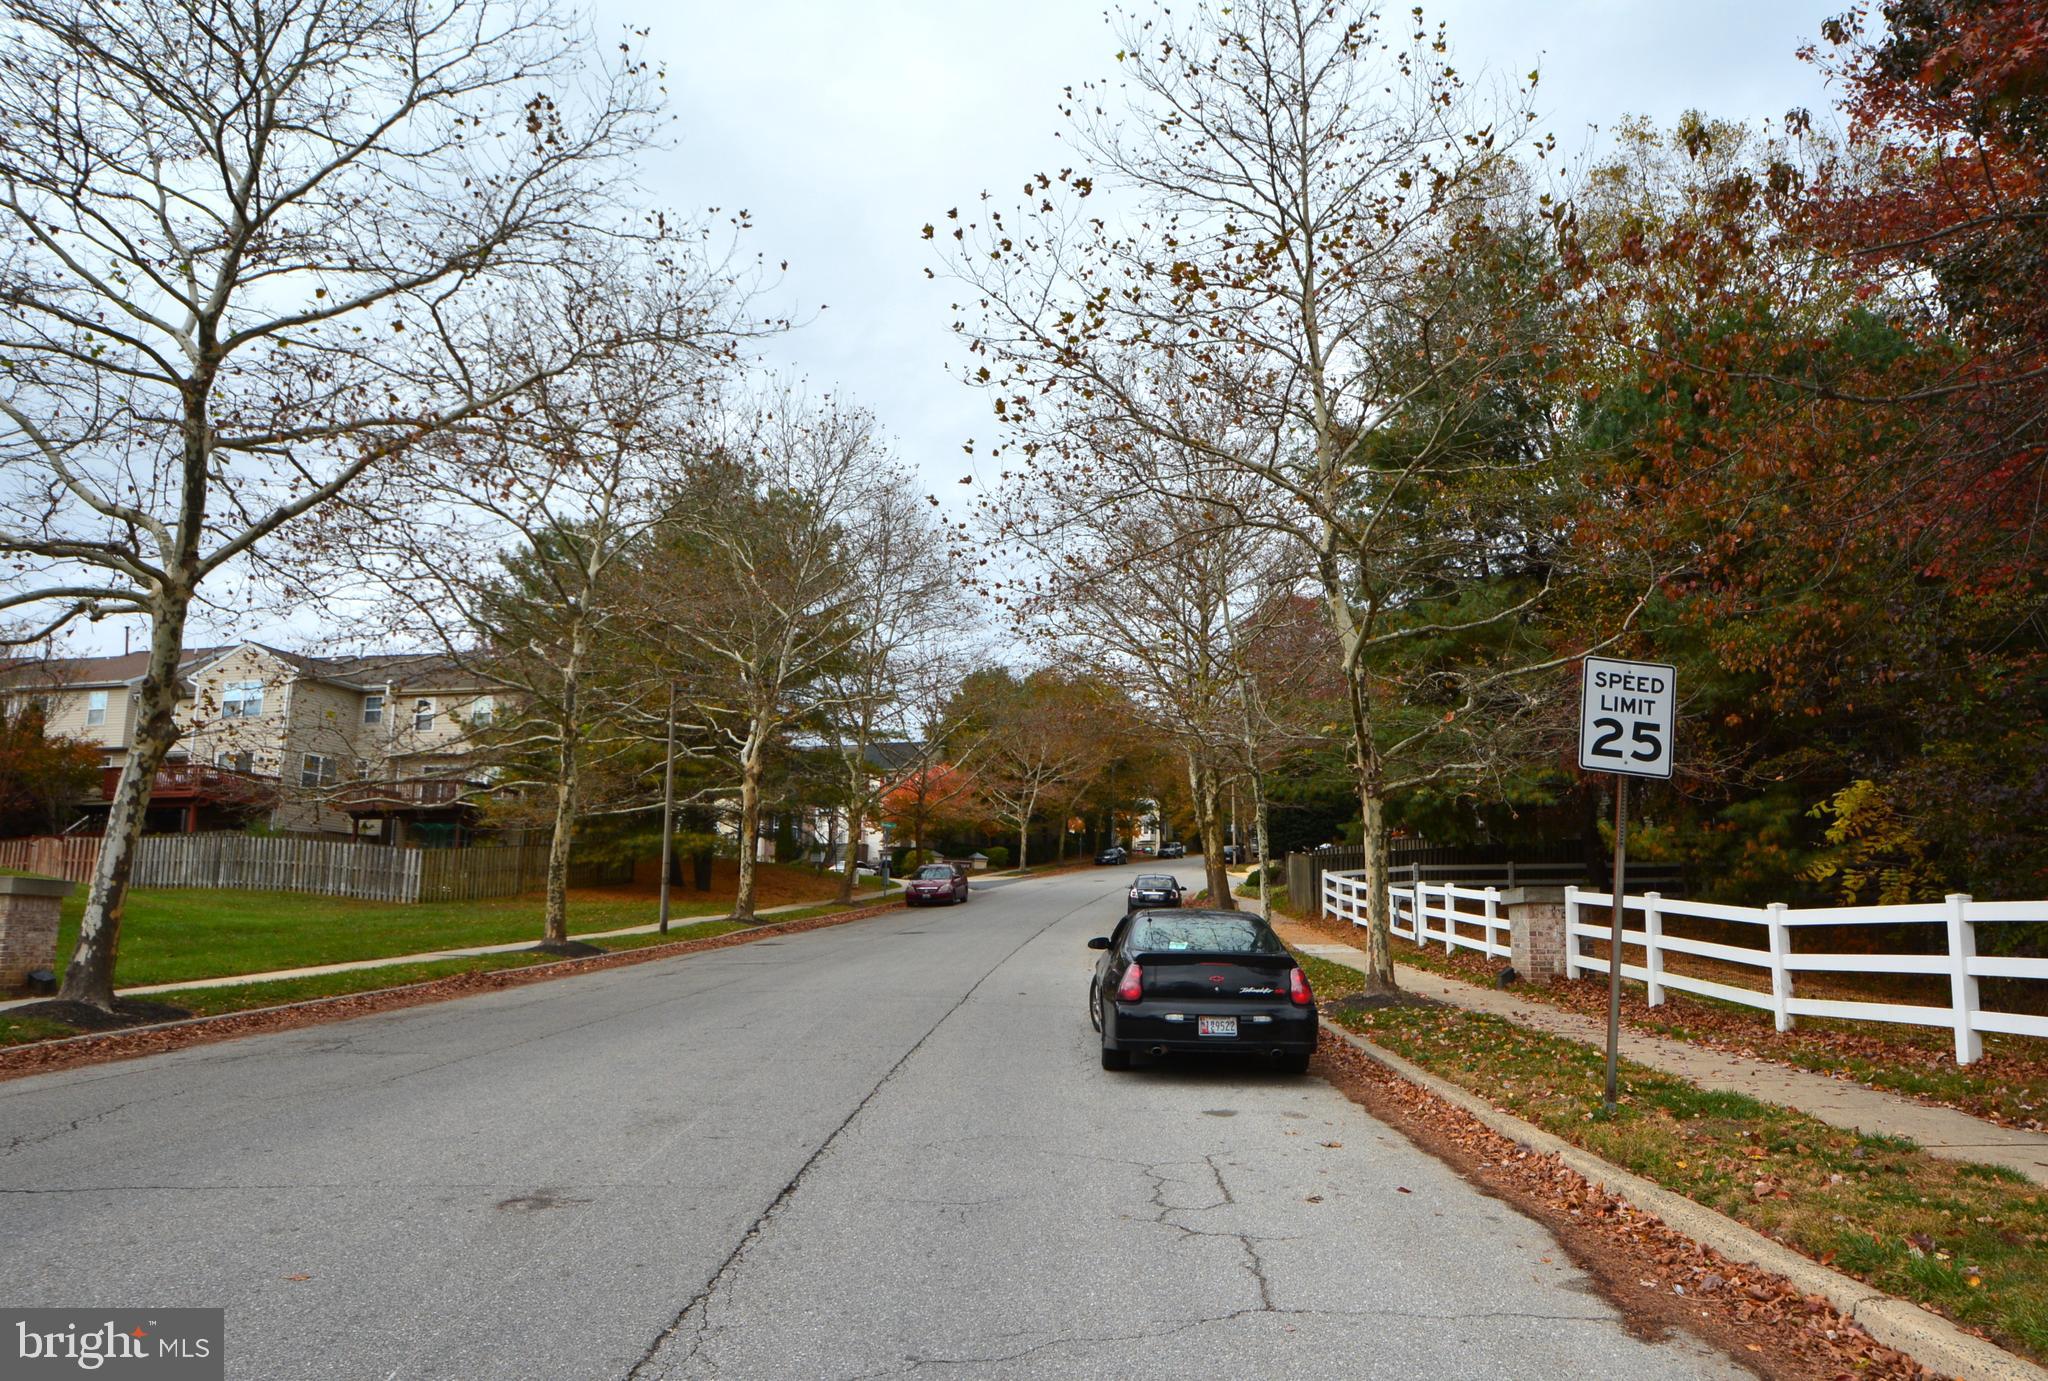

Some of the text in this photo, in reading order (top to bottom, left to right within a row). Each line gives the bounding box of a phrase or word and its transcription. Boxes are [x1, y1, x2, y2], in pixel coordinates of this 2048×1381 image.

[1594, 671, 1665, 694] SPEED
[1600, 694, 1656, 716] LIMIT
[1591, 717, 1662, 762] 25
